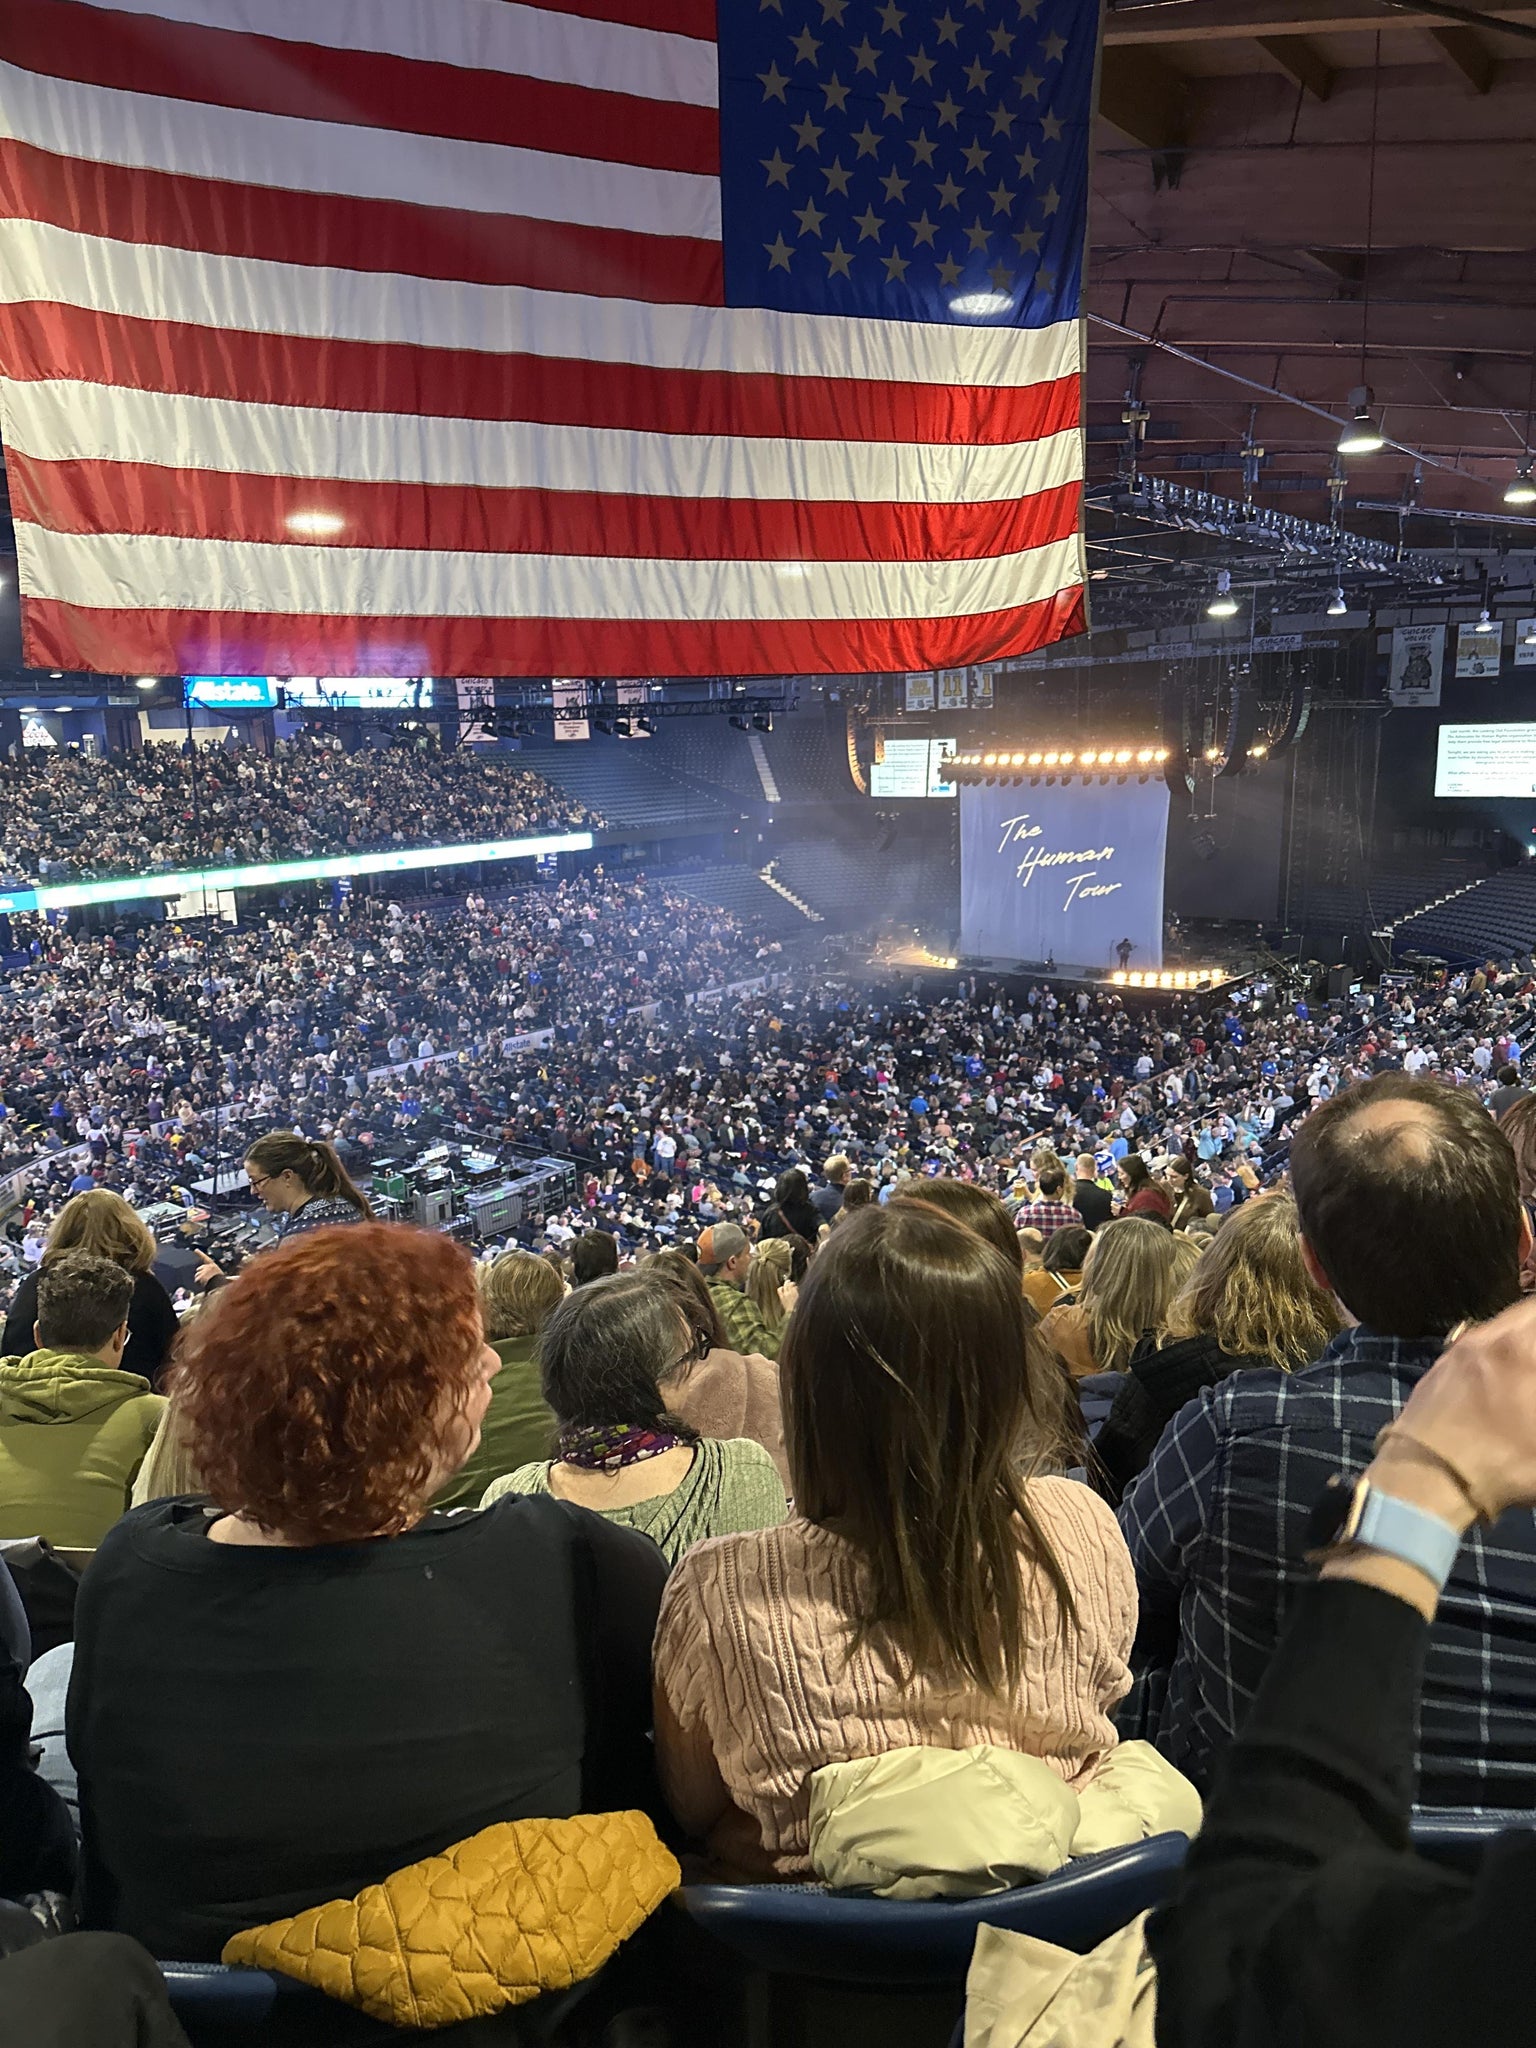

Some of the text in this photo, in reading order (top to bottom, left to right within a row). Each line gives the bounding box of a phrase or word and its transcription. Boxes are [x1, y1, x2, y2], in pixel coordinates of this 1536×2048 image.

[1402, 627, 1437, 636] CHICAGO
[943, 675, 963, 697] 11
[997, 814, 1043, 854] The
[1016, 846, 1115, 887] Human
[1063, 871, 1122, 912] Tour
[504, 1039, 531, 1053] Allstate
